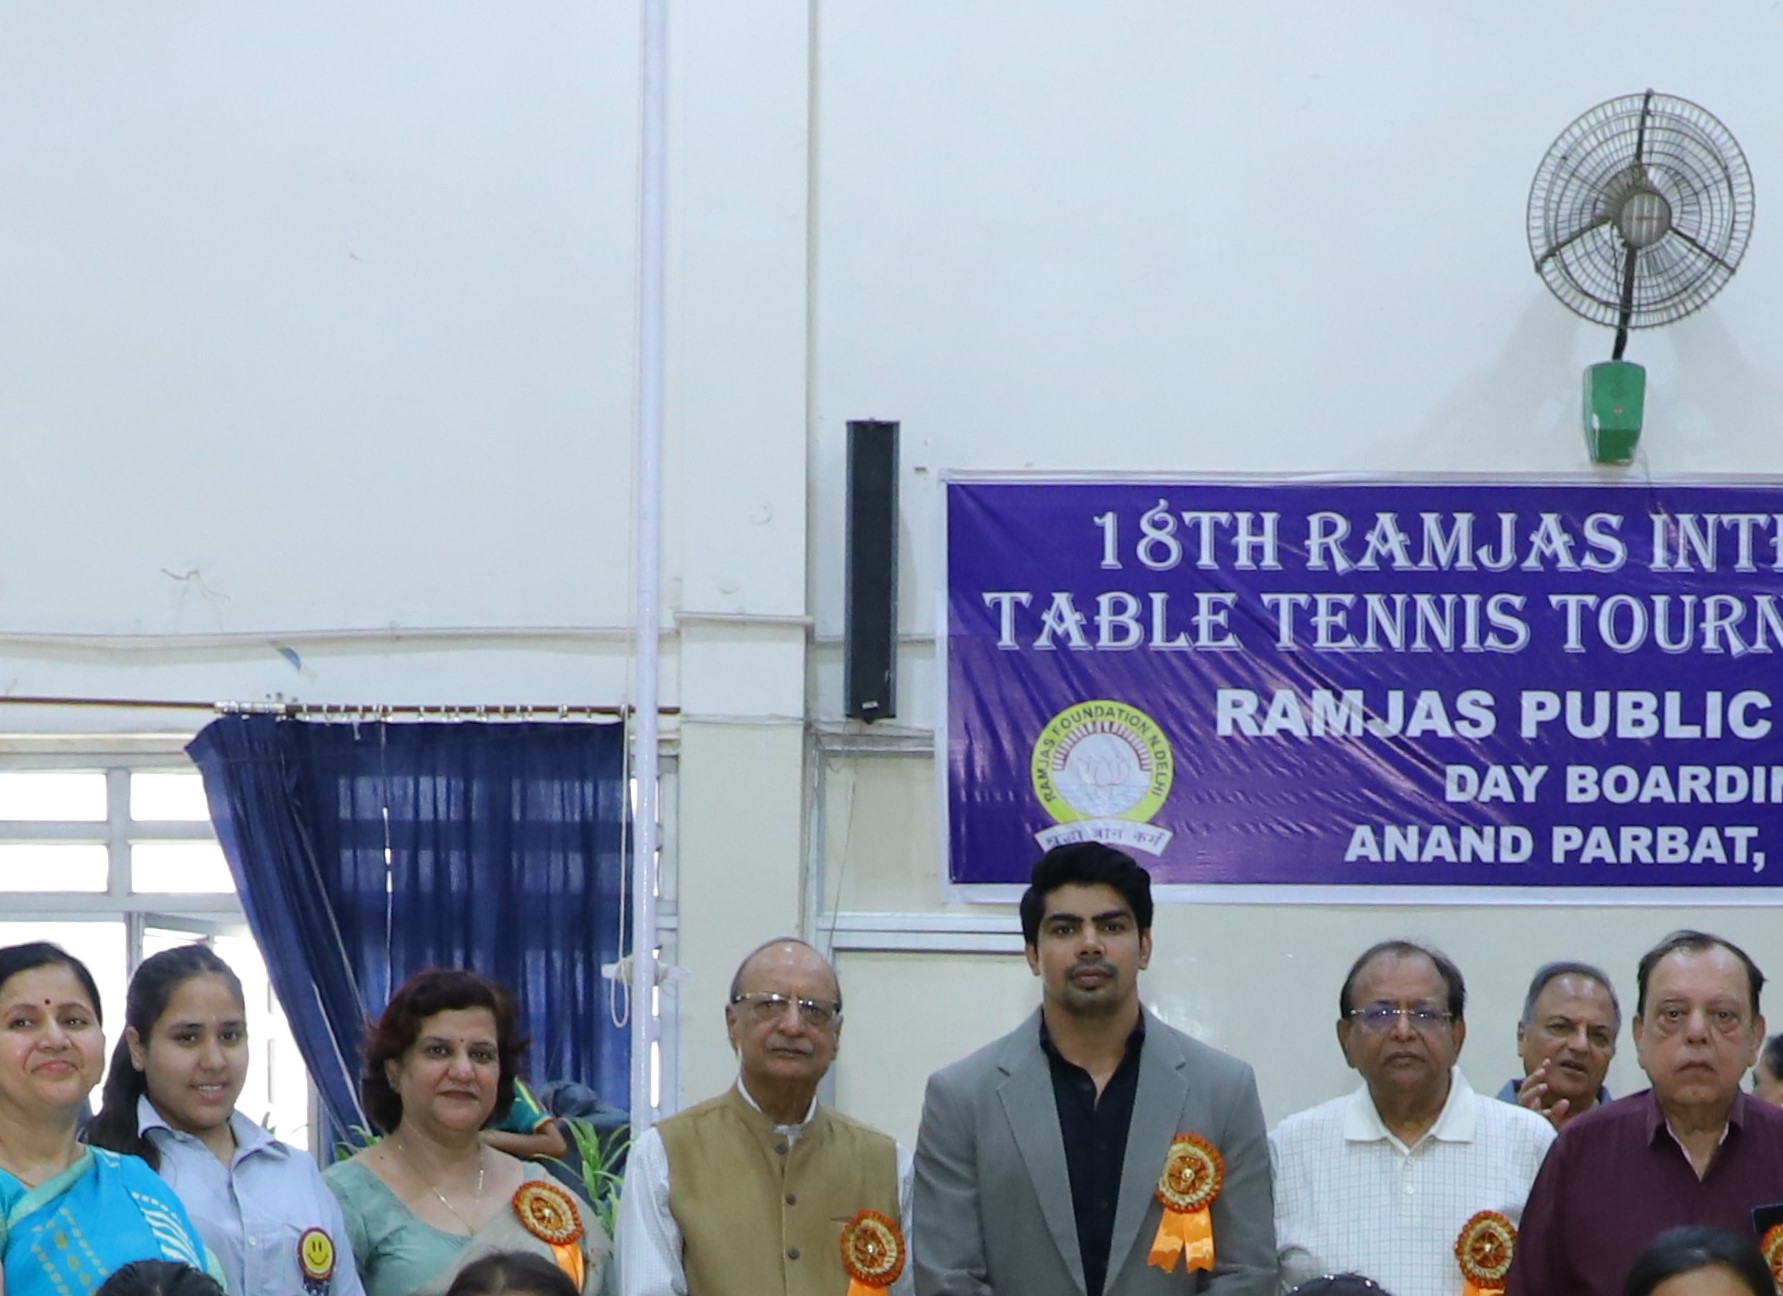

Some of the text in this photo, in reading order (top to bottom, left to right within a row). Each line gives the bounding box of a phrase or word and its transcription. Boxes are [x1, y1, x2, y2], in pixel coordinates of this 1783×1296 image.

[1092, 498, 1285, 572] 18TH
[1304, 511, 1629, 575] RAMJAS
[982, 590, 1246, 653] TABLE
[1259, 592, 1532, 655] TENNIS
[1216, 689, 1498, 740] RAMJAS
[1520, 690, 1773, 740] PUBLIC
[1036, 739, 1057, 802] RAMJAS
[1052, 706, 1150, 736] FOUNDATION
[1445, 765, 1548, 803] DAY
[1345, 826, 1539, 863] ANAND
[1552, 827, 1766, 872] PARBAT,
